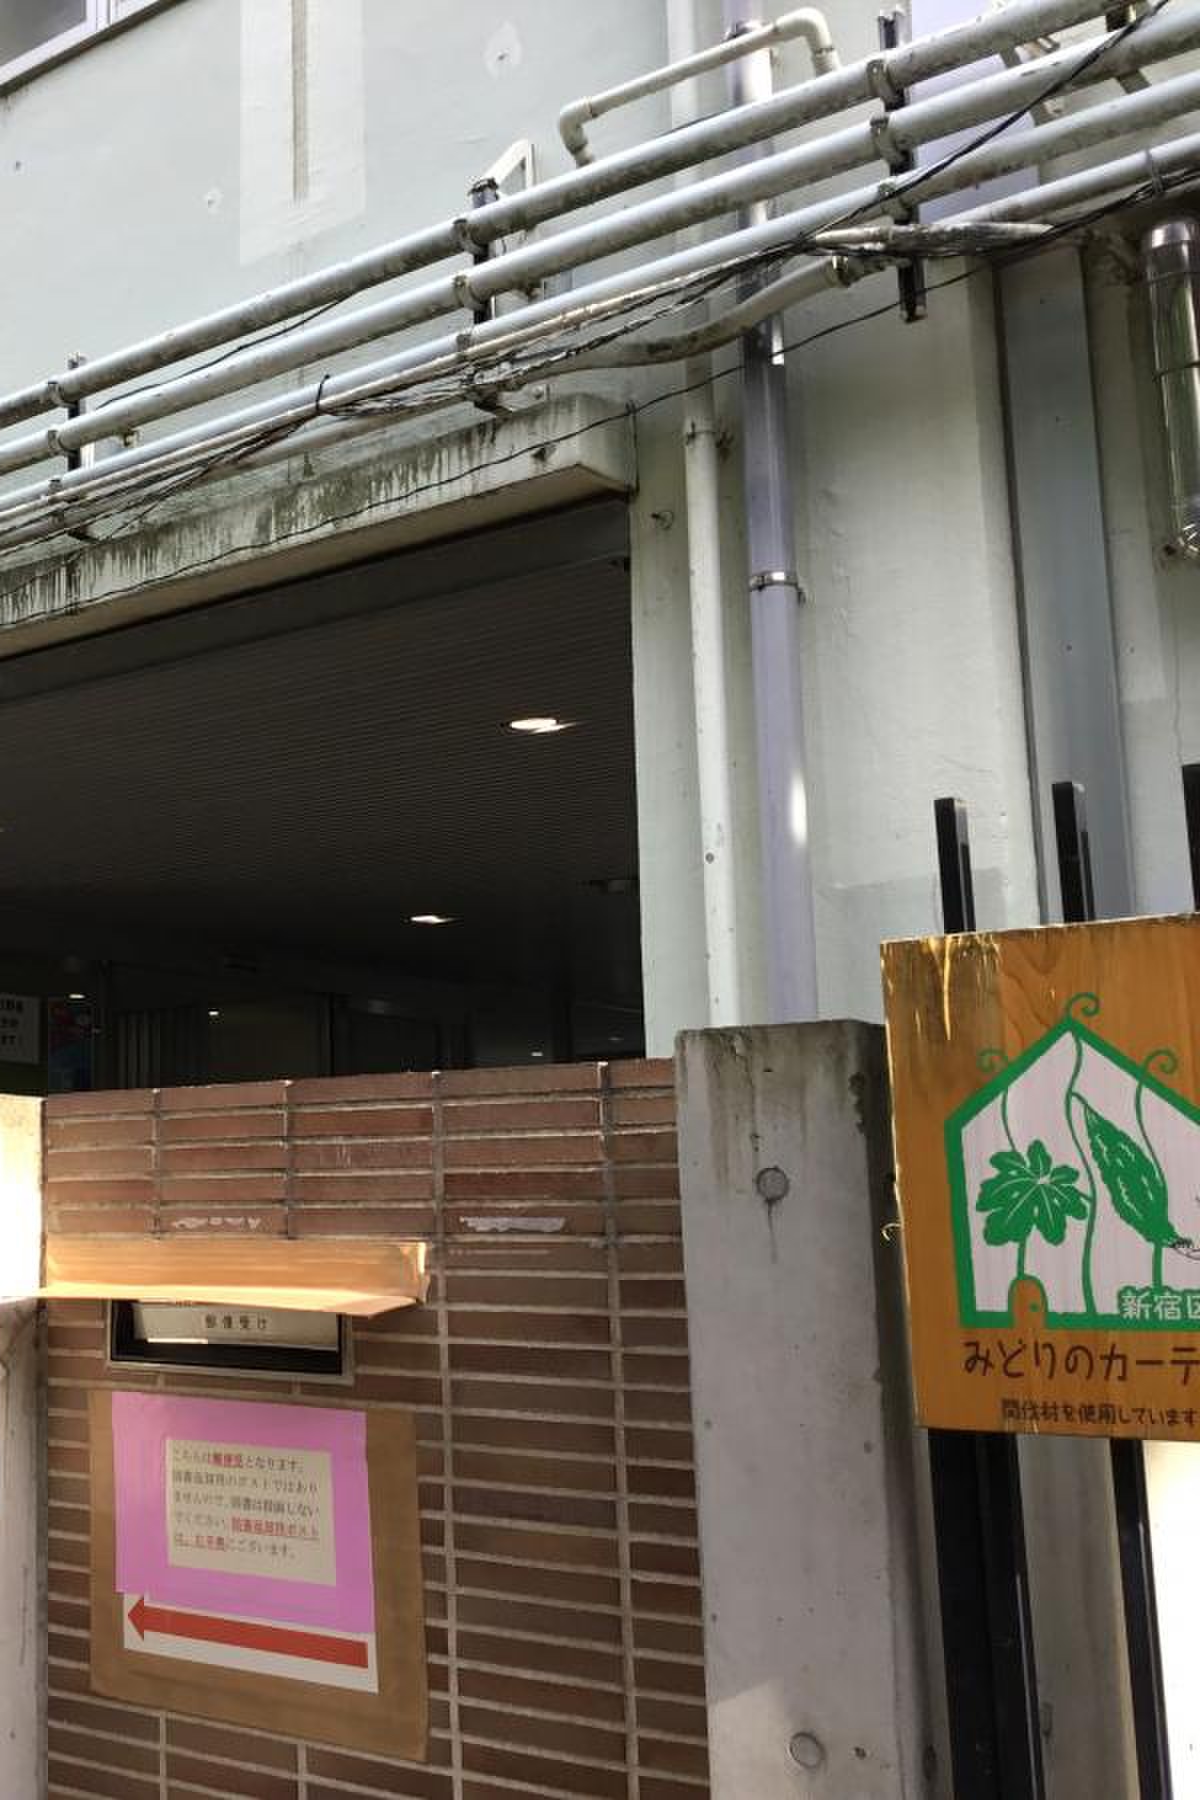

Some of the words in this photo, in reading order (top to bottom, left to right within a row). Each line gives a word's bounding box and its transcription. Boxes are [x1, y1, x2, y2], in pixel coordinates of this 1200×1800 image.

[963, 1339, 1200, 1386] みどりのカーテ
